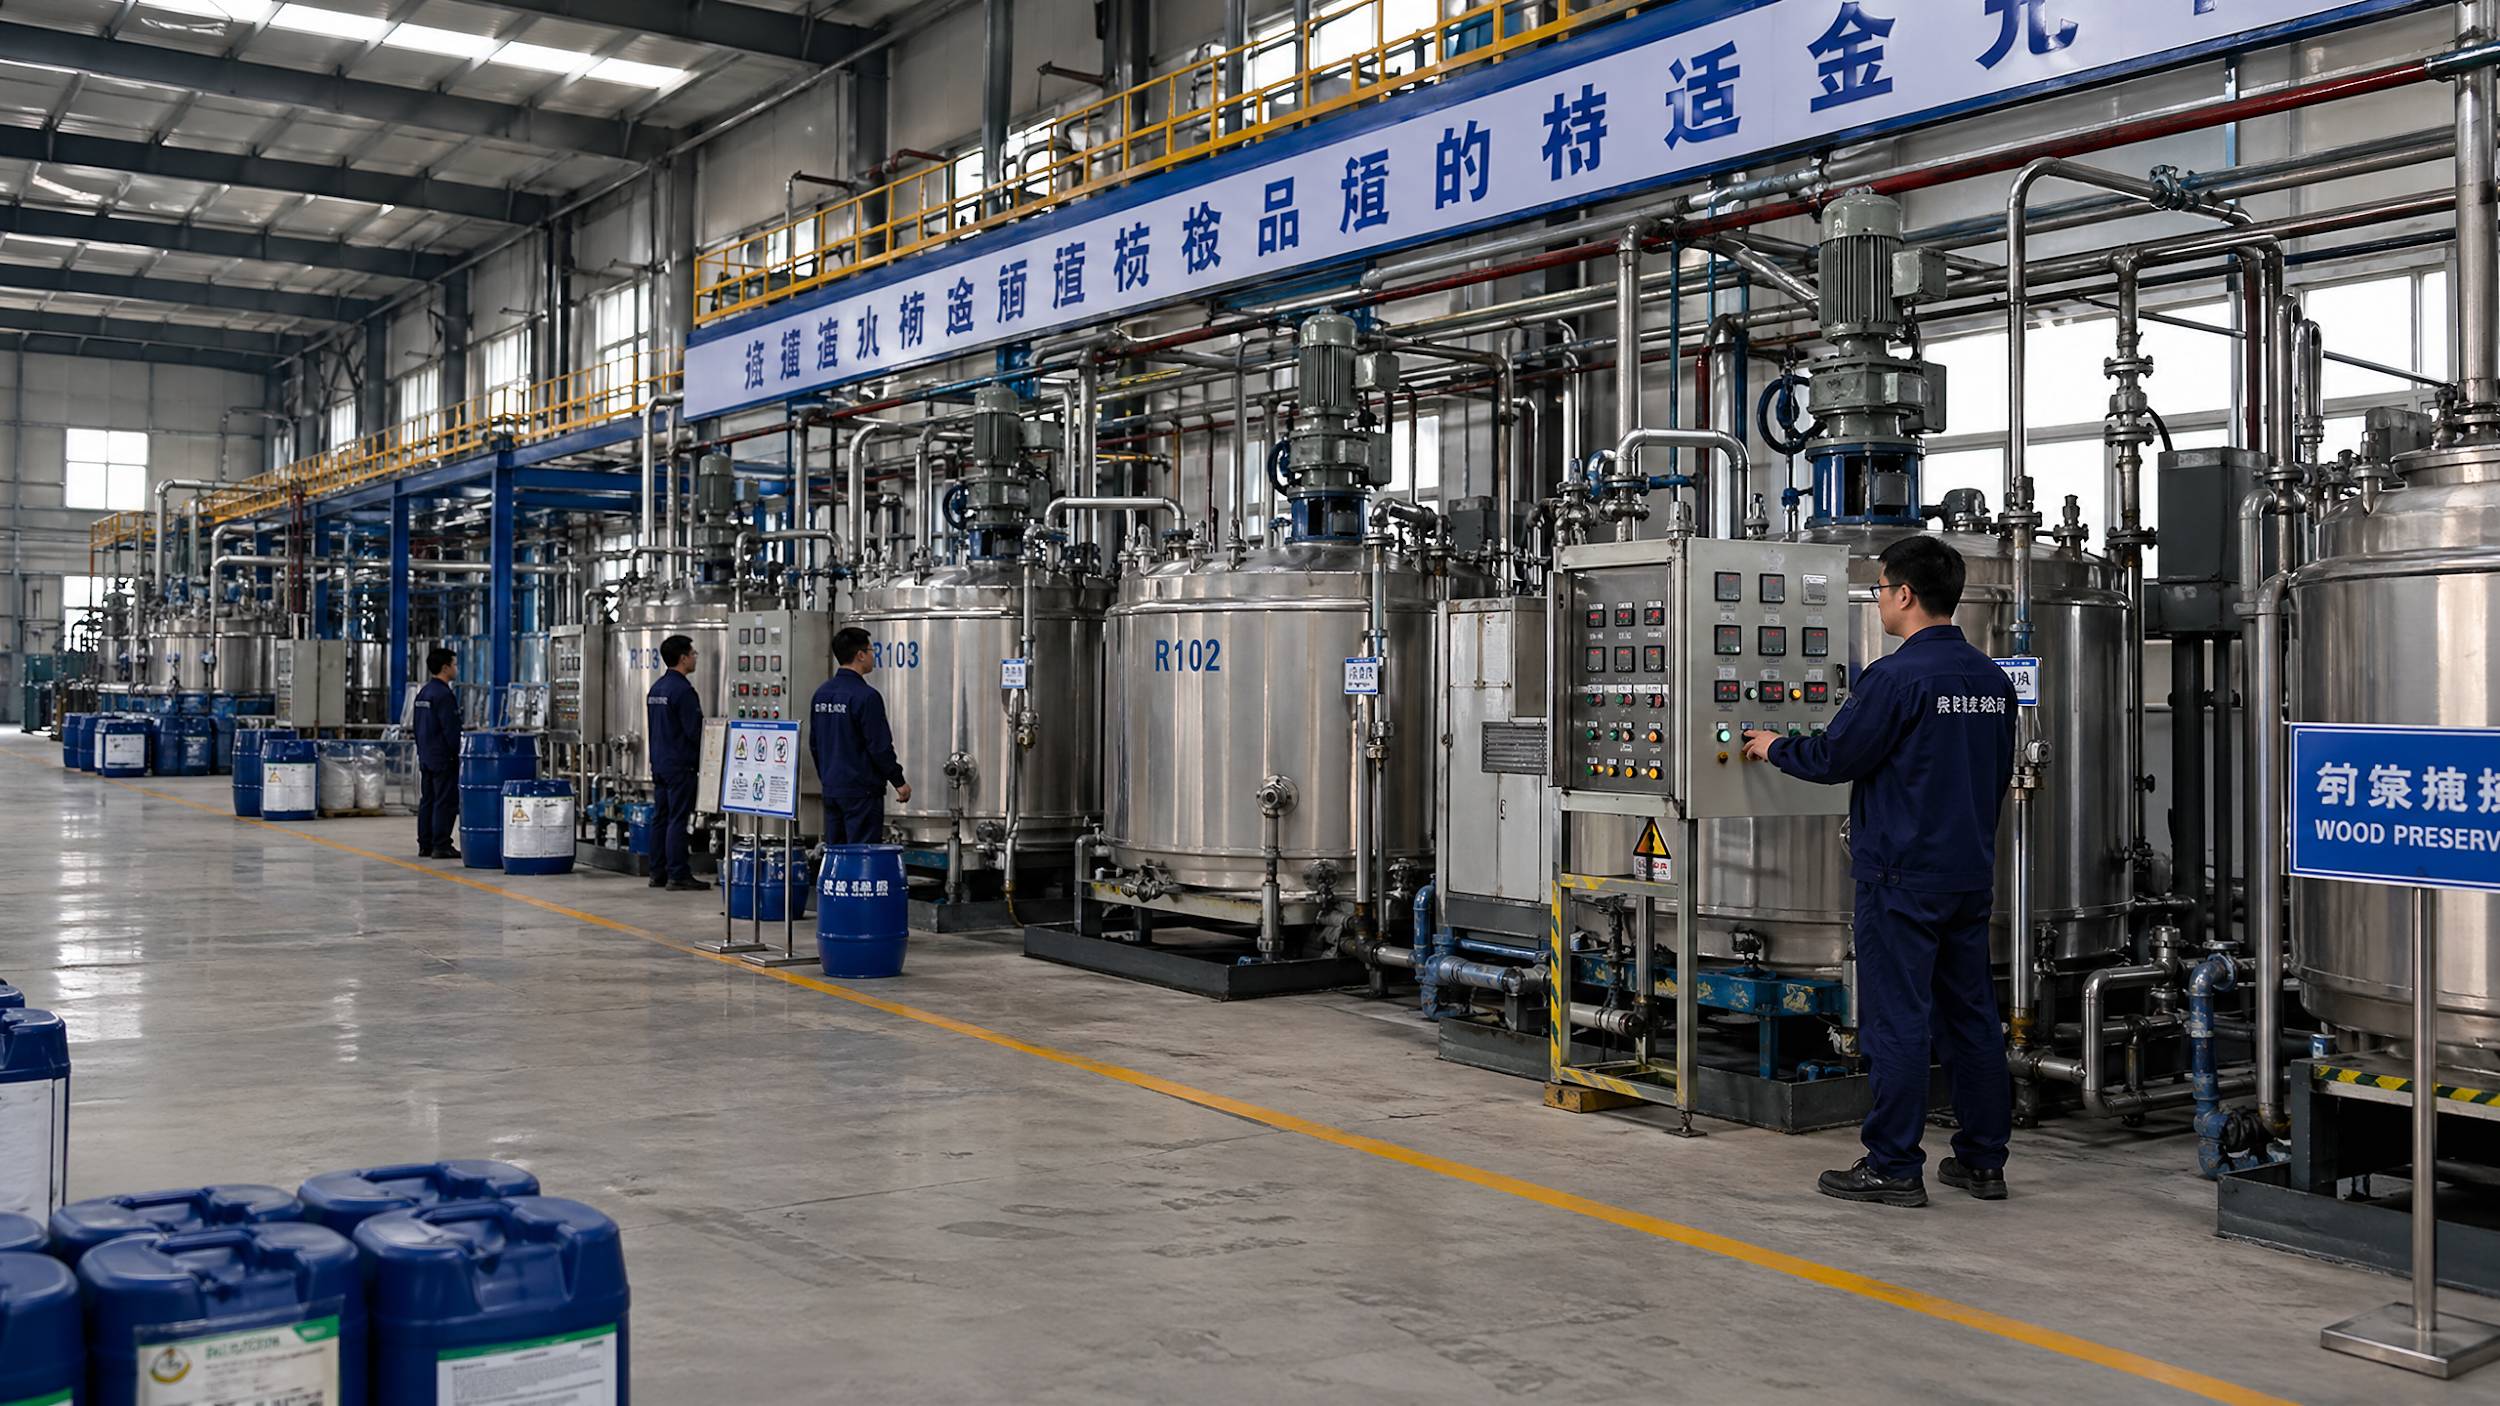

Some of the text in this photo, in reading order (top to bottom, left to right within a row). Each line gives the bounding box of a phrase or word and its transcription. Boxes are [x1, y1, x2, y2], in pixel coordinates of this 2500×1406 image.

[873, 641, 919, 669] R103
[1155, 639, 1221, 672] R102
[2315, 819, 2500, 852] WOOD PRESERV
